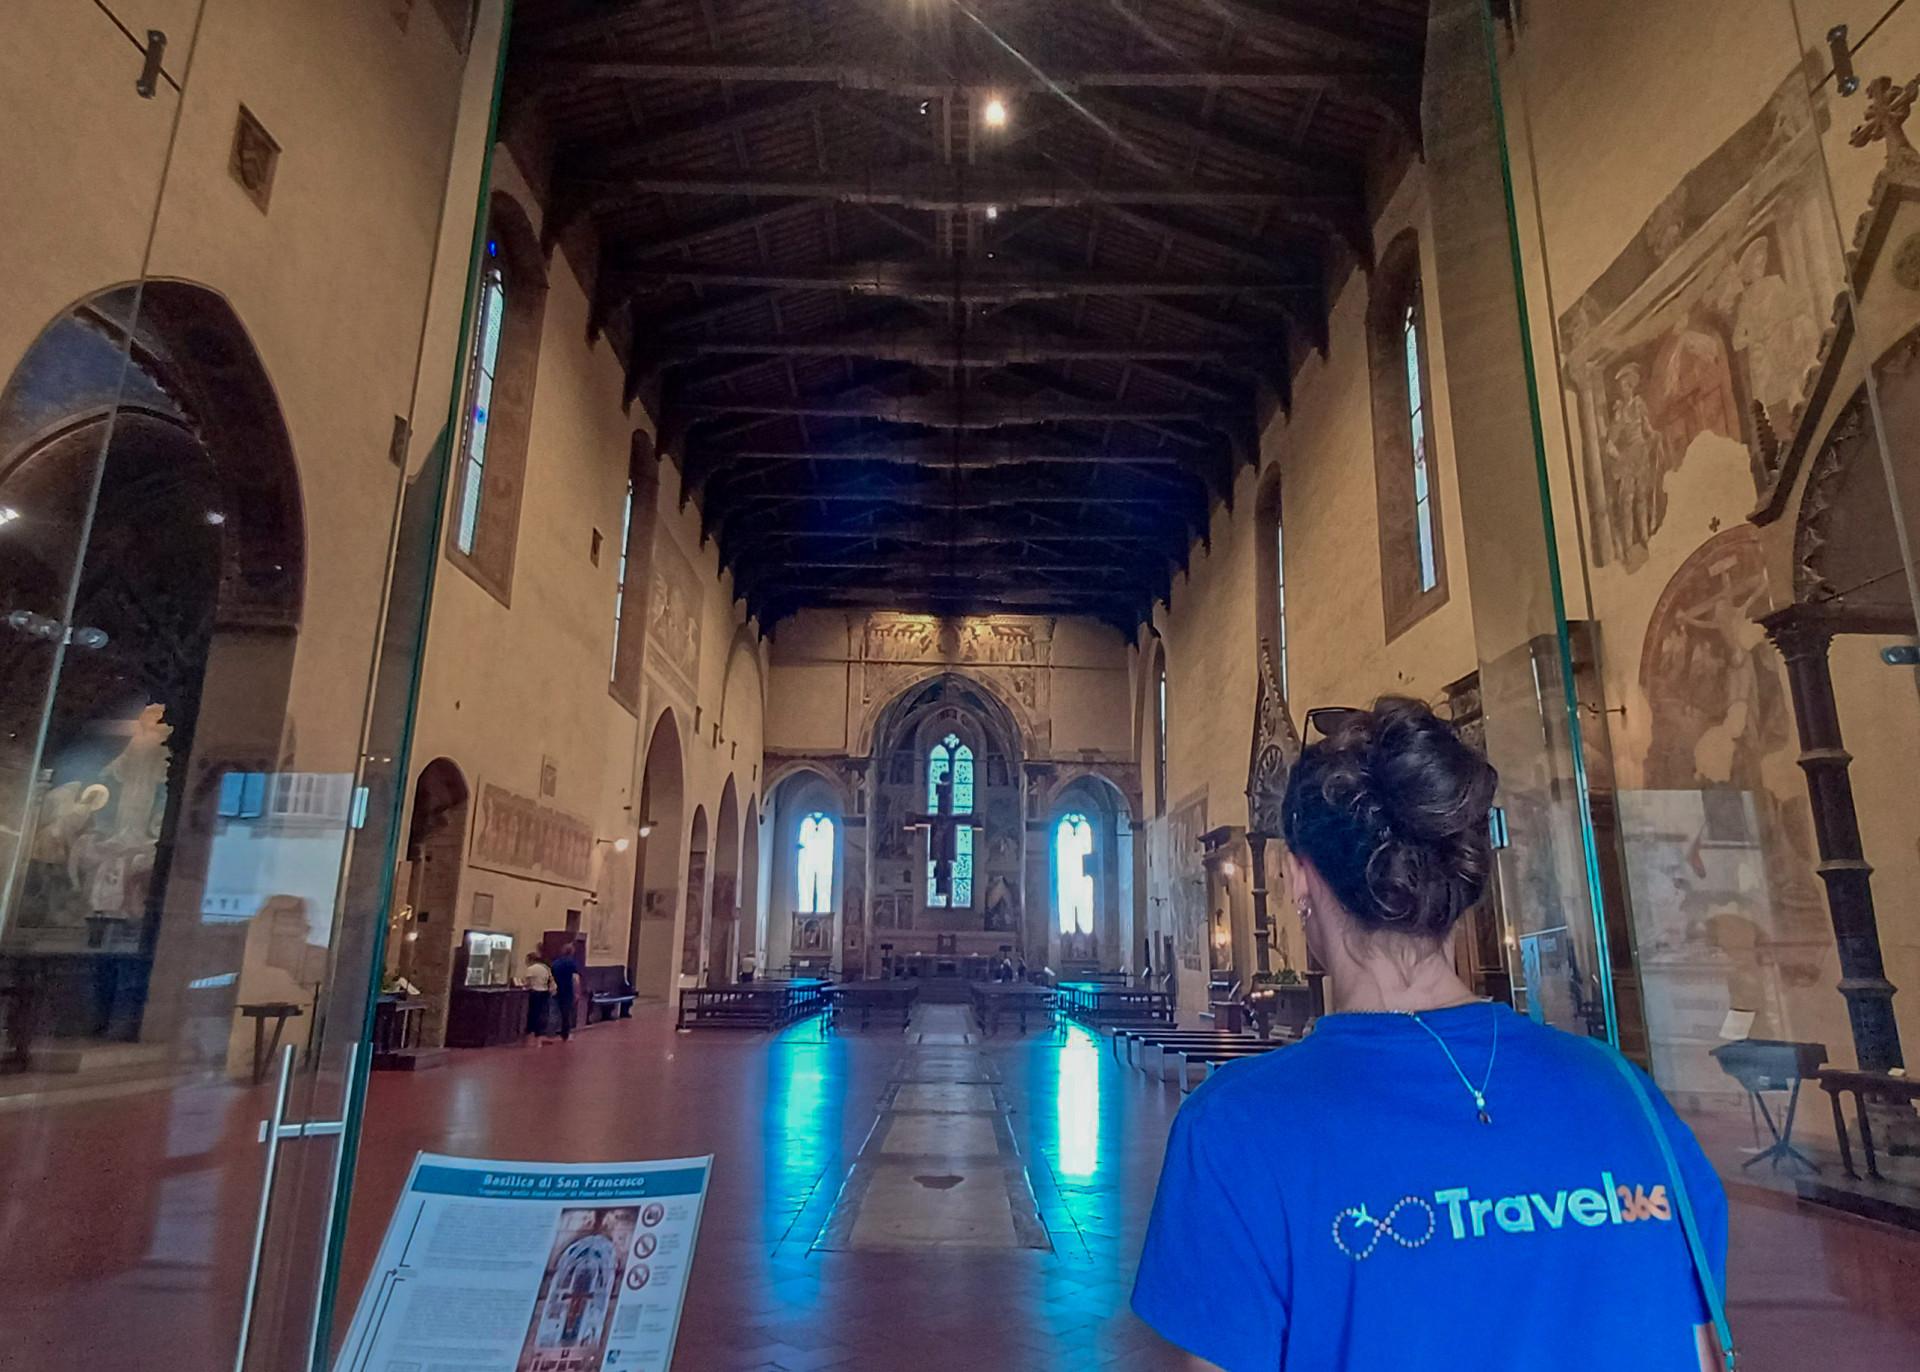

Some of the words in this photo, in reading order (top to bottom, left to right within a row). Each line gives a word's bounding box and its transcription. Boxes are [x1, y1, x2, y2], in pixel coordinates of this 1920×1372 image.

[483, 1174, 534, 1188] Basilica
[539, 1177, 552, 1188] di
[557, 1176, 580, 1188] San
[585, 1176, 645, 1188] Francesco
